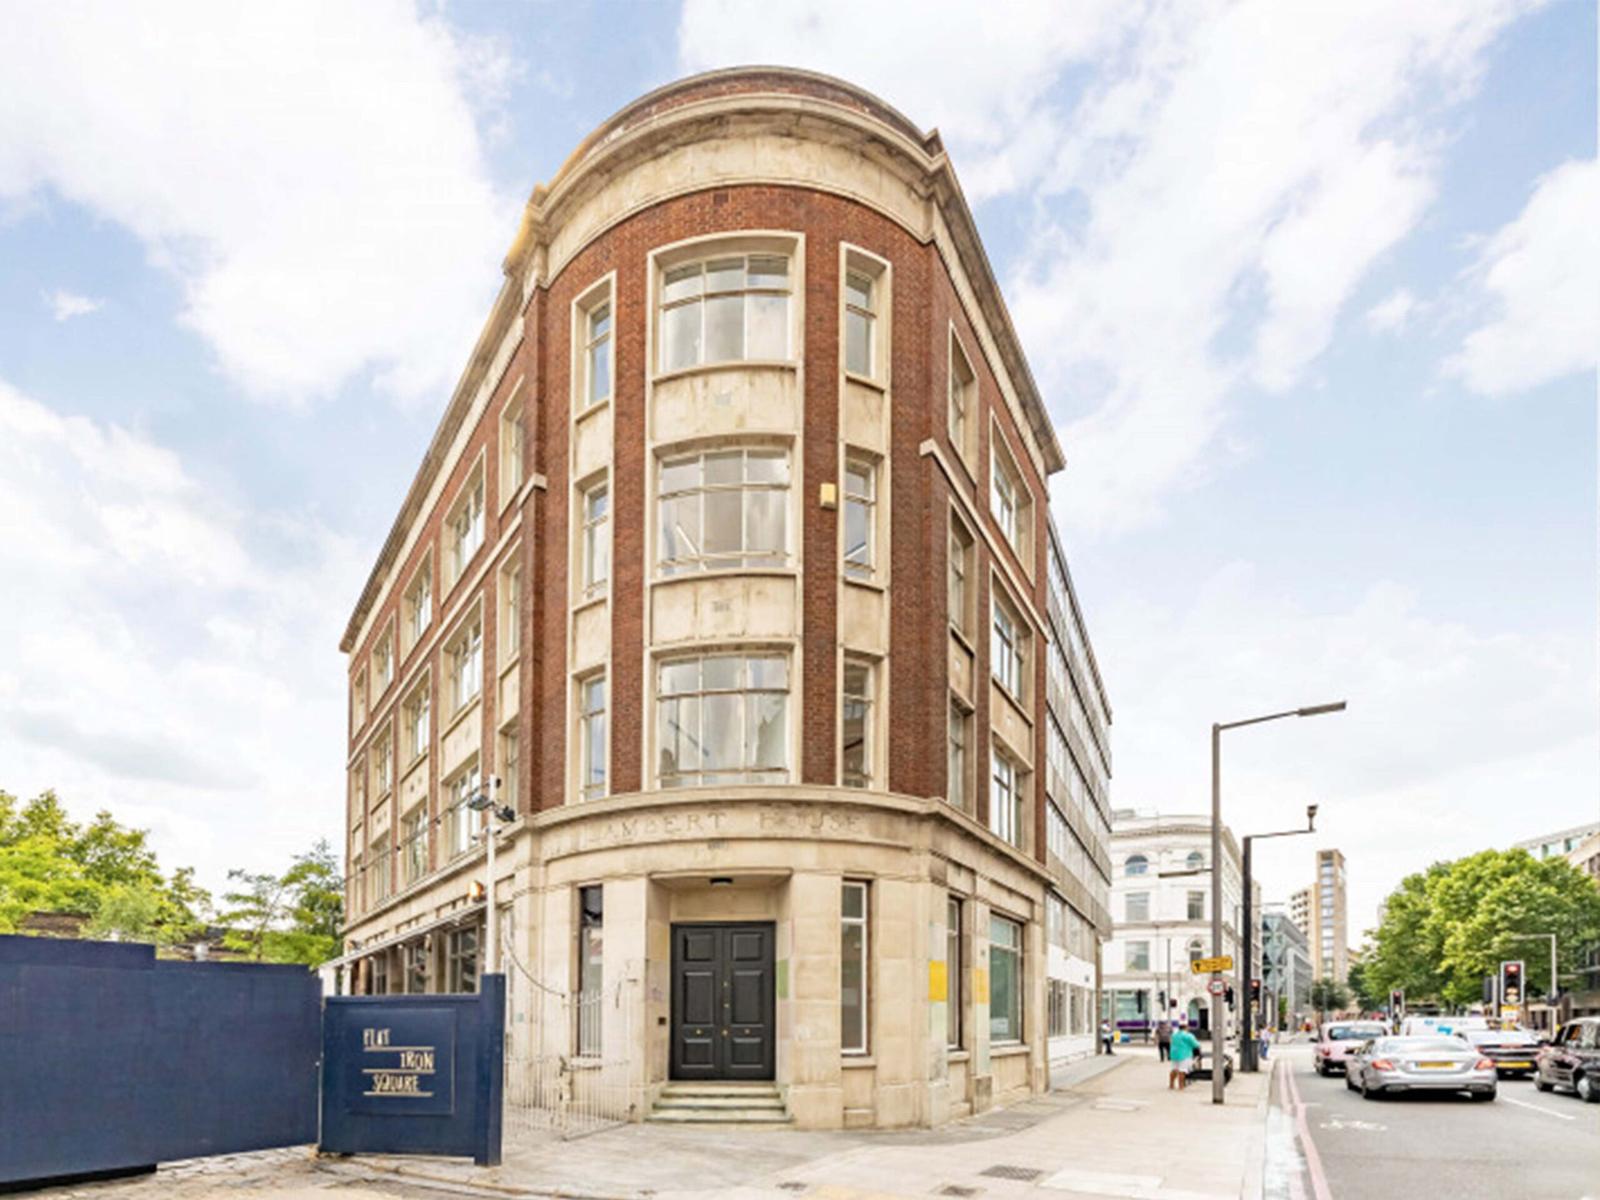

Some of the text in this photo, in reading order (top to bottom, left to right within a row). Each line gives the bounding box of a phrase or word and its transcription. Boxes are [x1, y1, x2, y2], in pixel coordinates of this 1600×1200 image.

[363, 1028, 390, 1047] FLAT
[400, 1051, 434, 1070] IRON
[373, 1073, 418, 1093] SQUARE
